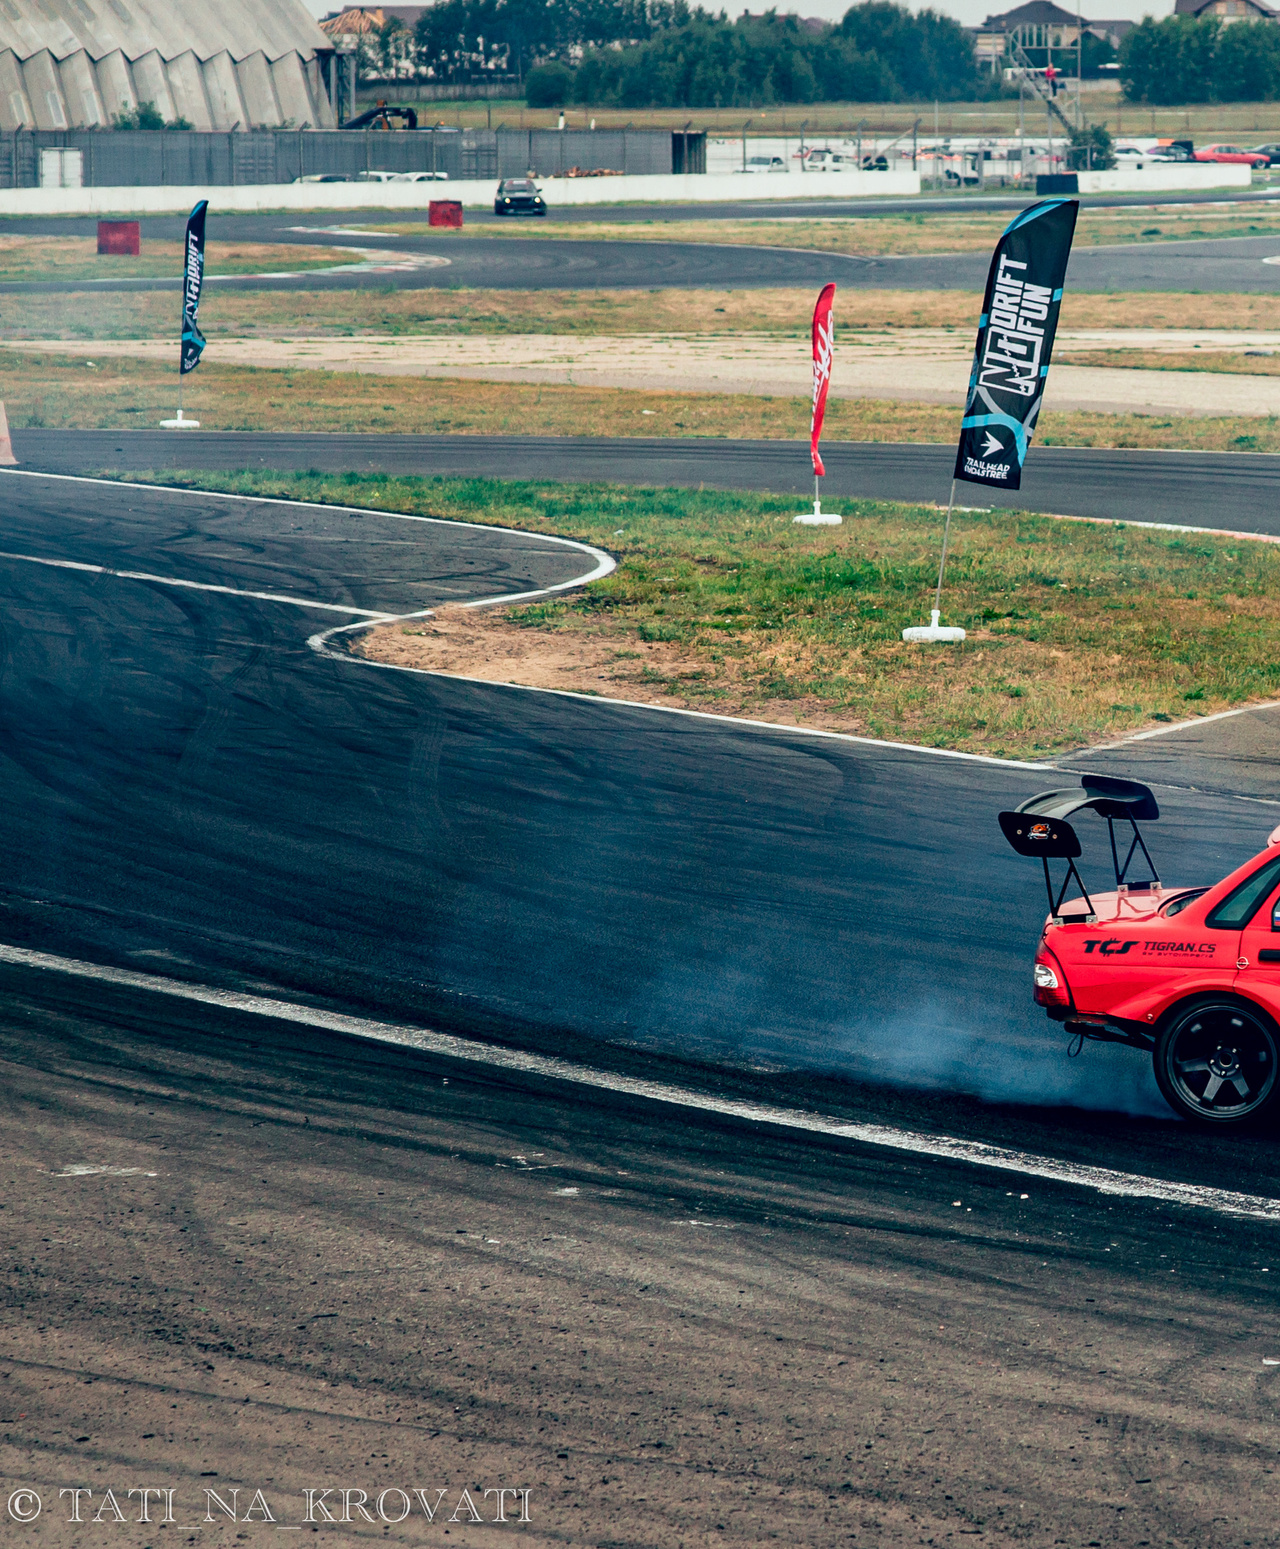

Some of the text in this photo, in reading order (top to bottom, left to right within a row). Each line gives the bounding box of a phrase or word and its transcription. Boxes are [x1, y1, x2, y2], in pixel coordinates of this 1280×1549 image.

[188, 230, 199, 276] DRIFT
[990, 254, 1027, 331] DRIFT
[1017, 283, 1052, 335] FUN
[1083, 938, 1217, 957] TCS TIGRAN.CS
